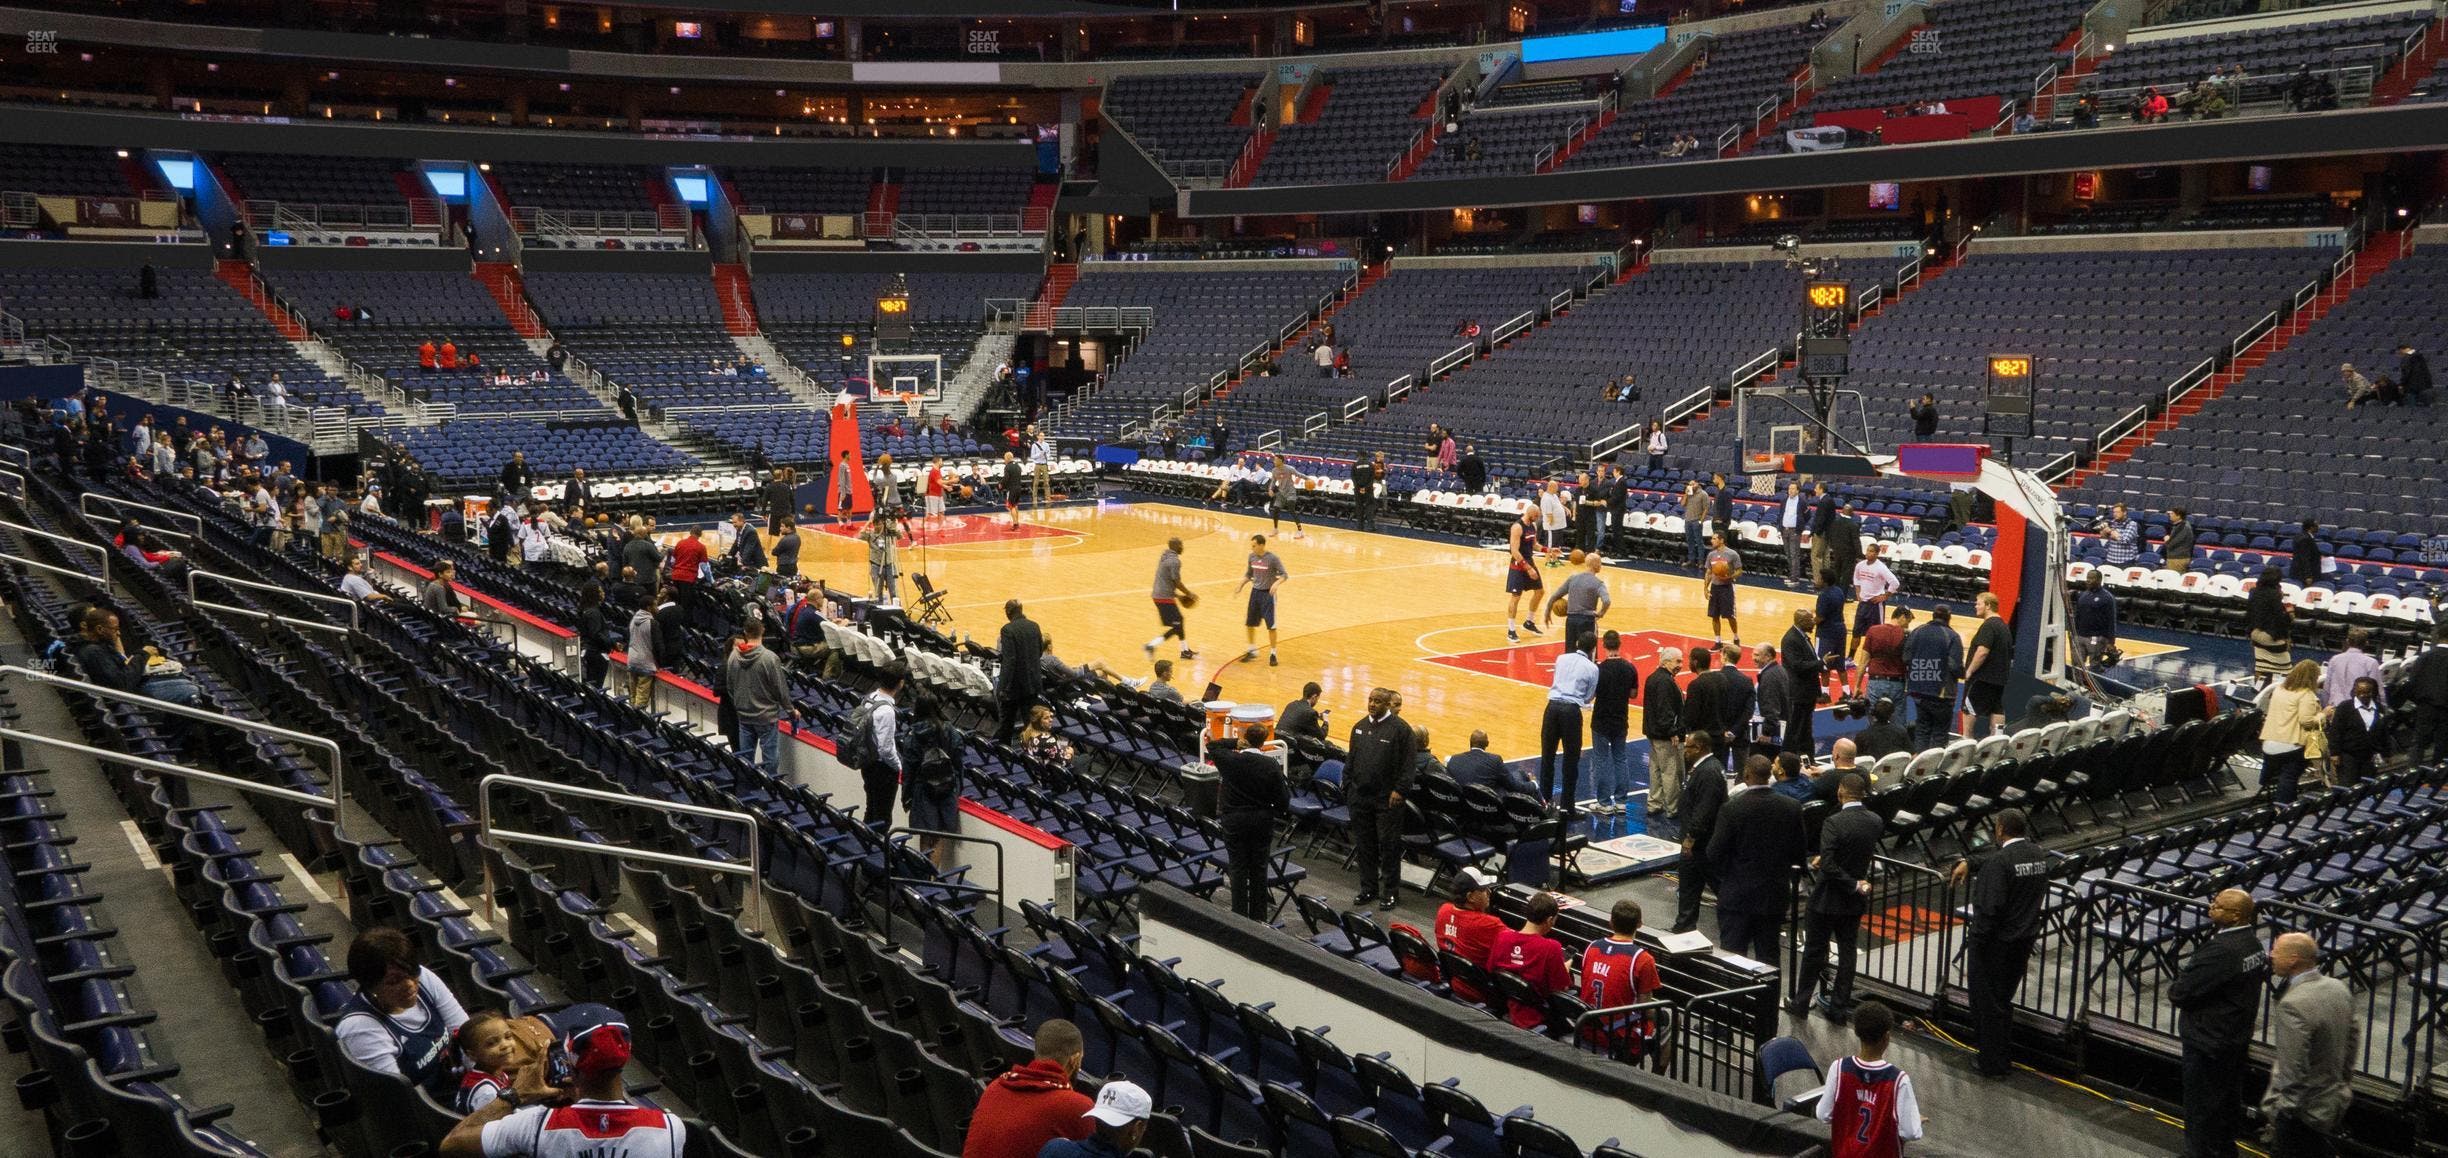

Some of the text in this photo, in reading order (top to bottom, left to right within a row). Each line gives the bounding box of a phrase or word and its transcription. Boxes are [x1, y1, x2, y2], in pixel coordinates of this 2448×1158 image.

[2316, 234, 2336, 247] 111
[1899, 246, 1915, 256] 112
[1810, 287, 1844, 305] 48:27
[880, 300, 906, 312] 48:27
[1994, 360, 2028, 375] 48:27
[534, 530, 541, 543] 2
[1592, 961, 1611, 978] BEAL
[1855, 1089, 1877, 1106] WALL
[1856, 1106, 1872, 1143] 2
